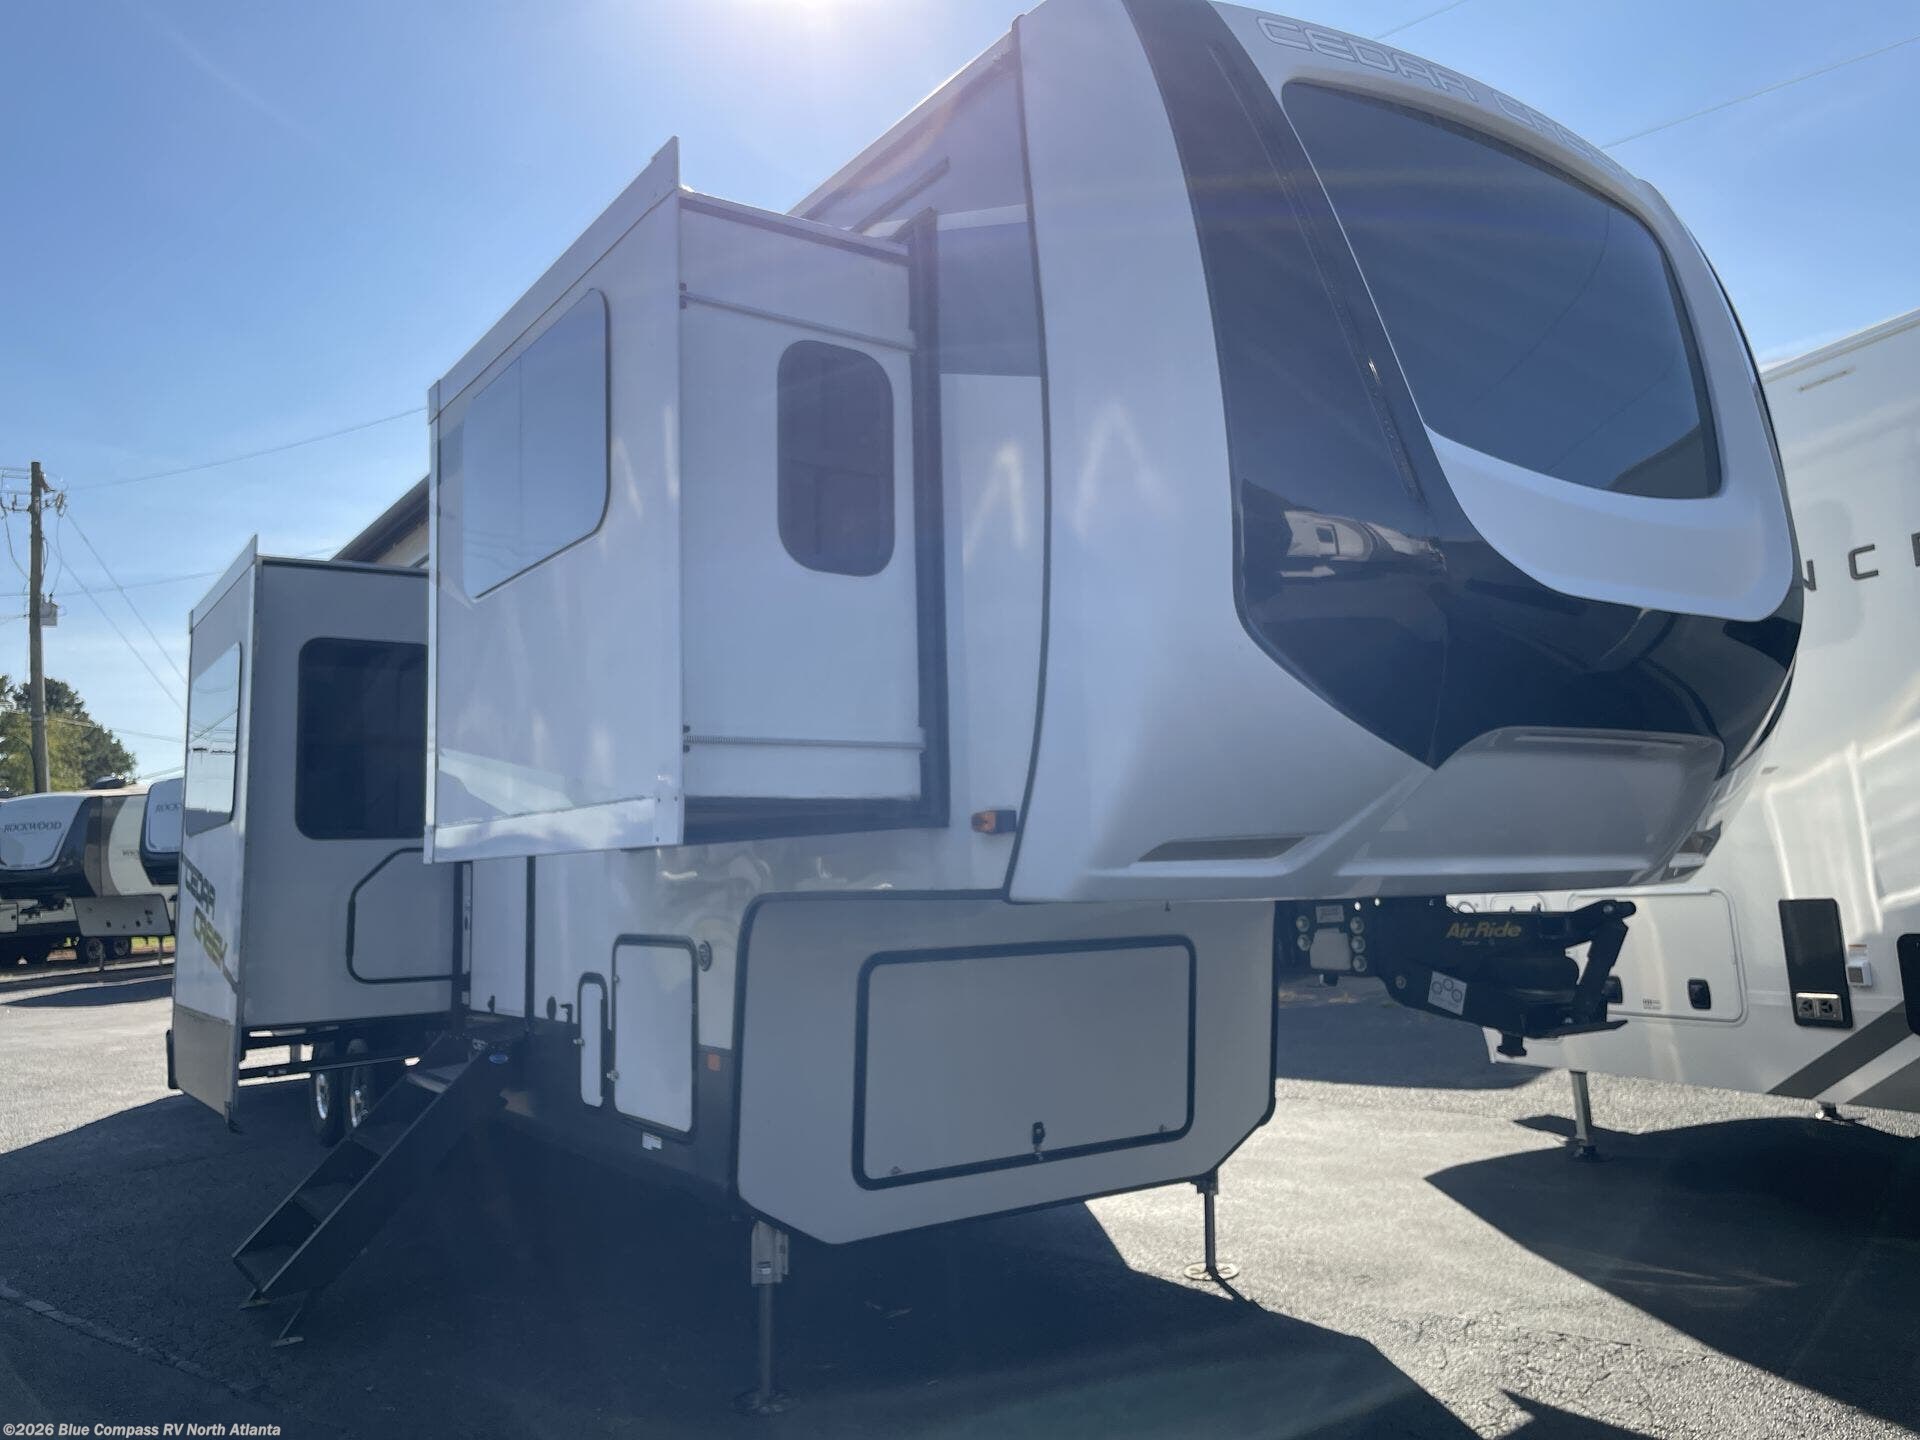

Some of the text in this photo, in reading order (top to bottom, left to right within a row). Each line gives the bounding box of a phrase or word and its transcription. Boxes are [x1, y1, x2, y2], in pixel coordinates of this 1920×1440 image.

[1256, 16, 1640, 188] CEDAR CRE
[3, 820, 62, 833] ROCKWOOD
[1445, 921, 1522, 939] Air Ride
